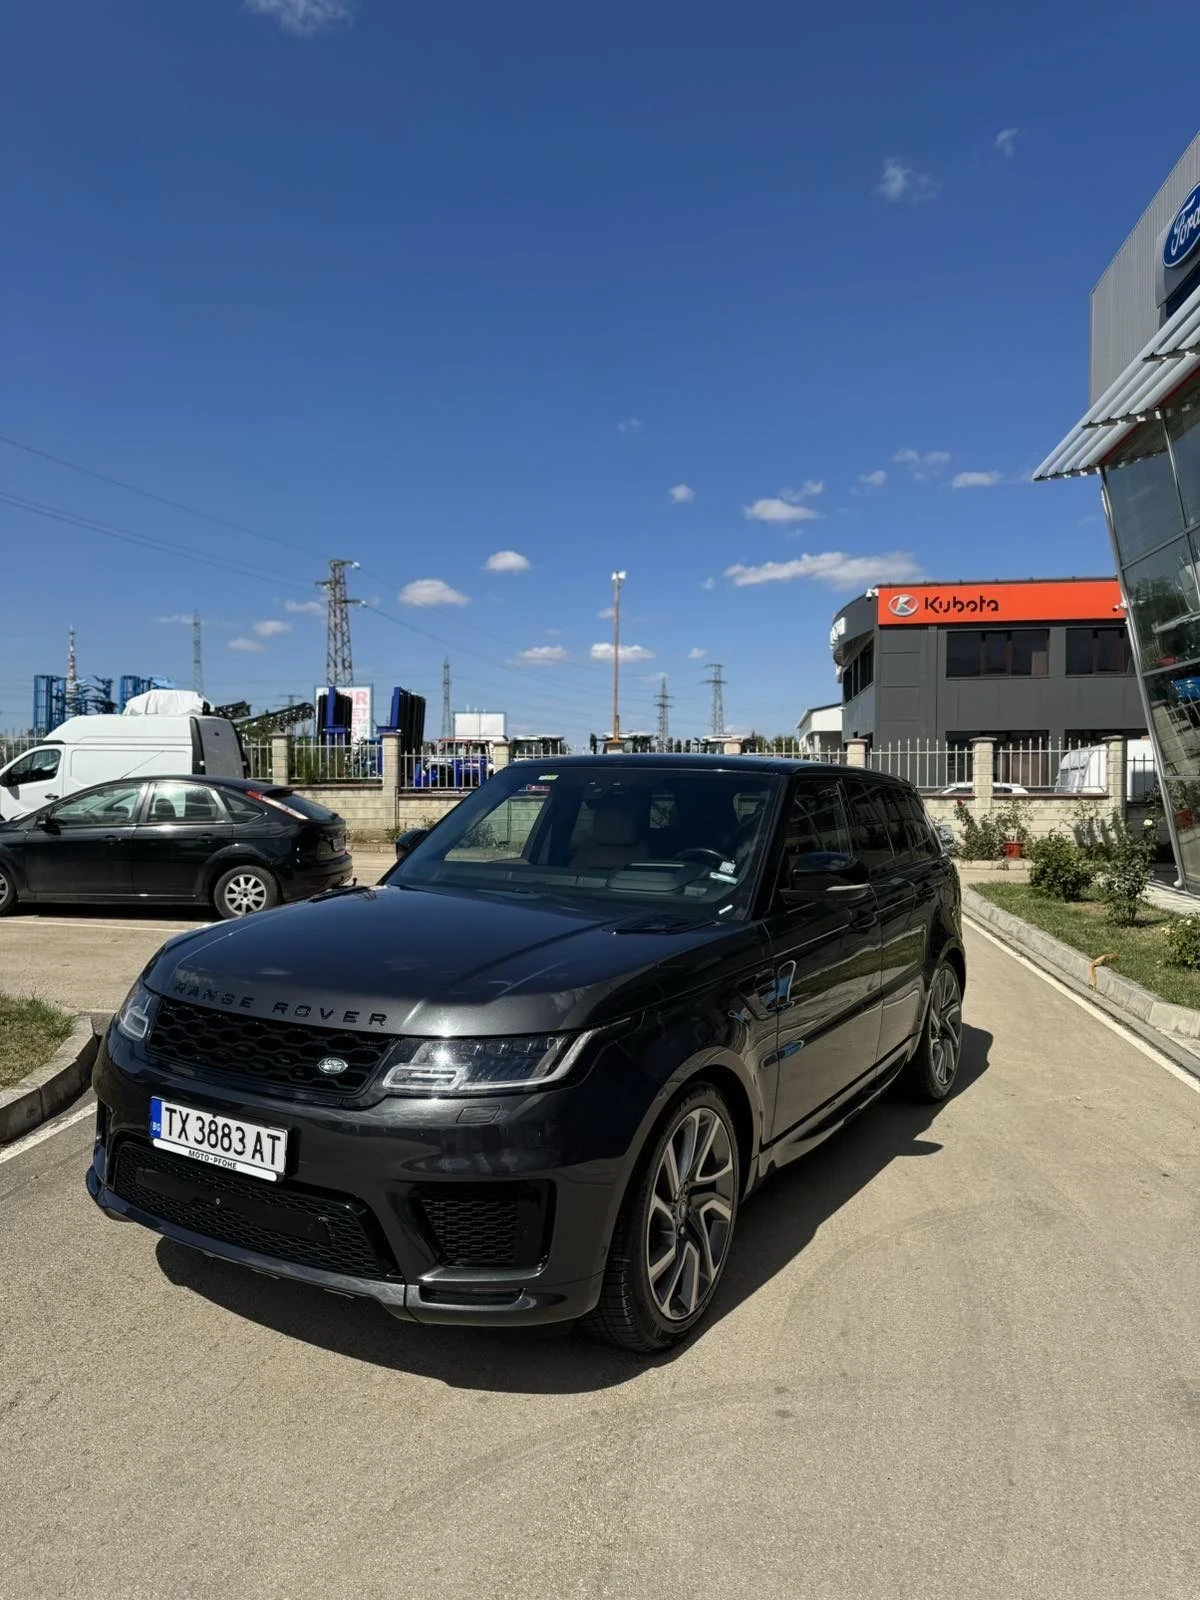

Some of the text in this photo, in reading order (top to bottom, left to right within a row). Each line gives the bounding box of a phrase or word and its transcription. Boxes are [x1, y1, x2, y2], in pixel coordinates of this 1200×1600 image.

[924, 595, 999, 614] Kubota
[173, 982, 388, 1026] RANGE ROVER
